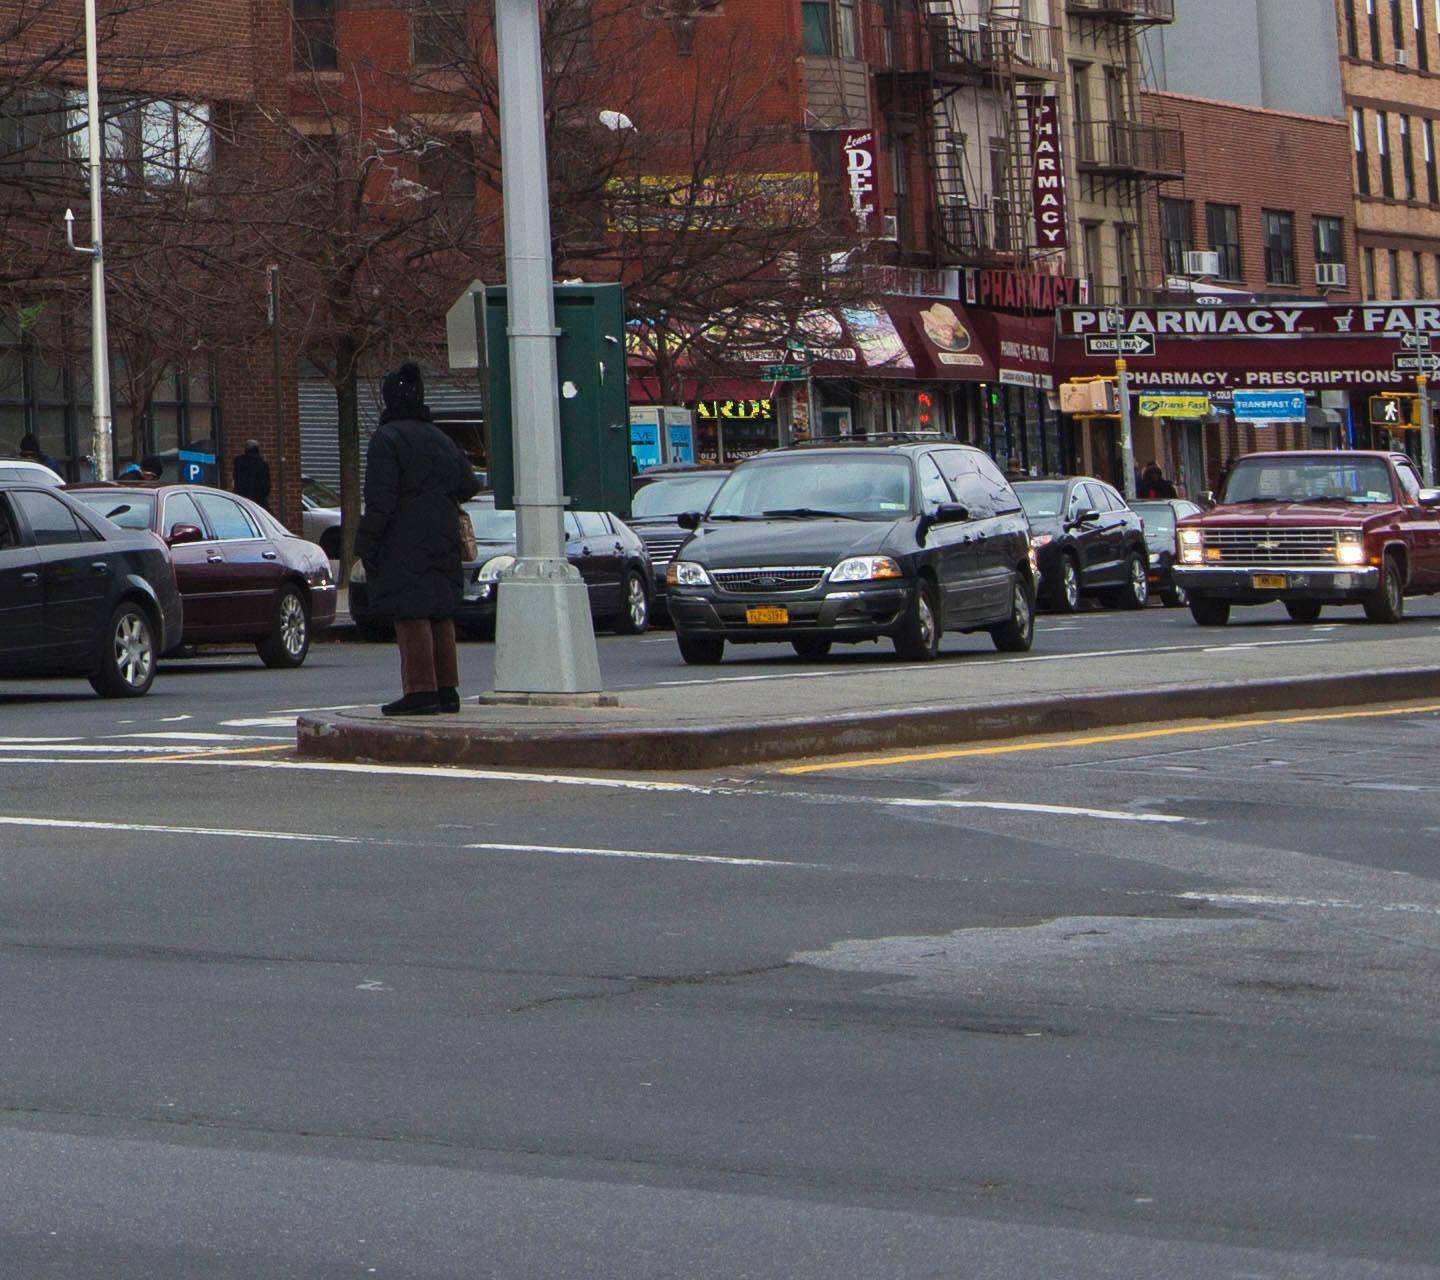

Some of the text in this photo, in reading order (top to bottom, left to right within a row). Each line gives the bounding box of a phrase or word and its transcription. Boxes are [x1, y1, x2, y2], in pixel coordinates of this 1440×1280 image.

[1035, 105, 1061, 242] PHARMACY
[981, 270, 1075, 308] PHARMACY
[1095, 340, 1143, 349] ONE WAY
[1125, 370, 1229, 385] PHARMACY
[1245, 369, 1402, 385] PRESCRIPTIONS
[1236, 400, 1289, 409] TRANSFAST
[190, 464, 200, 480] P
